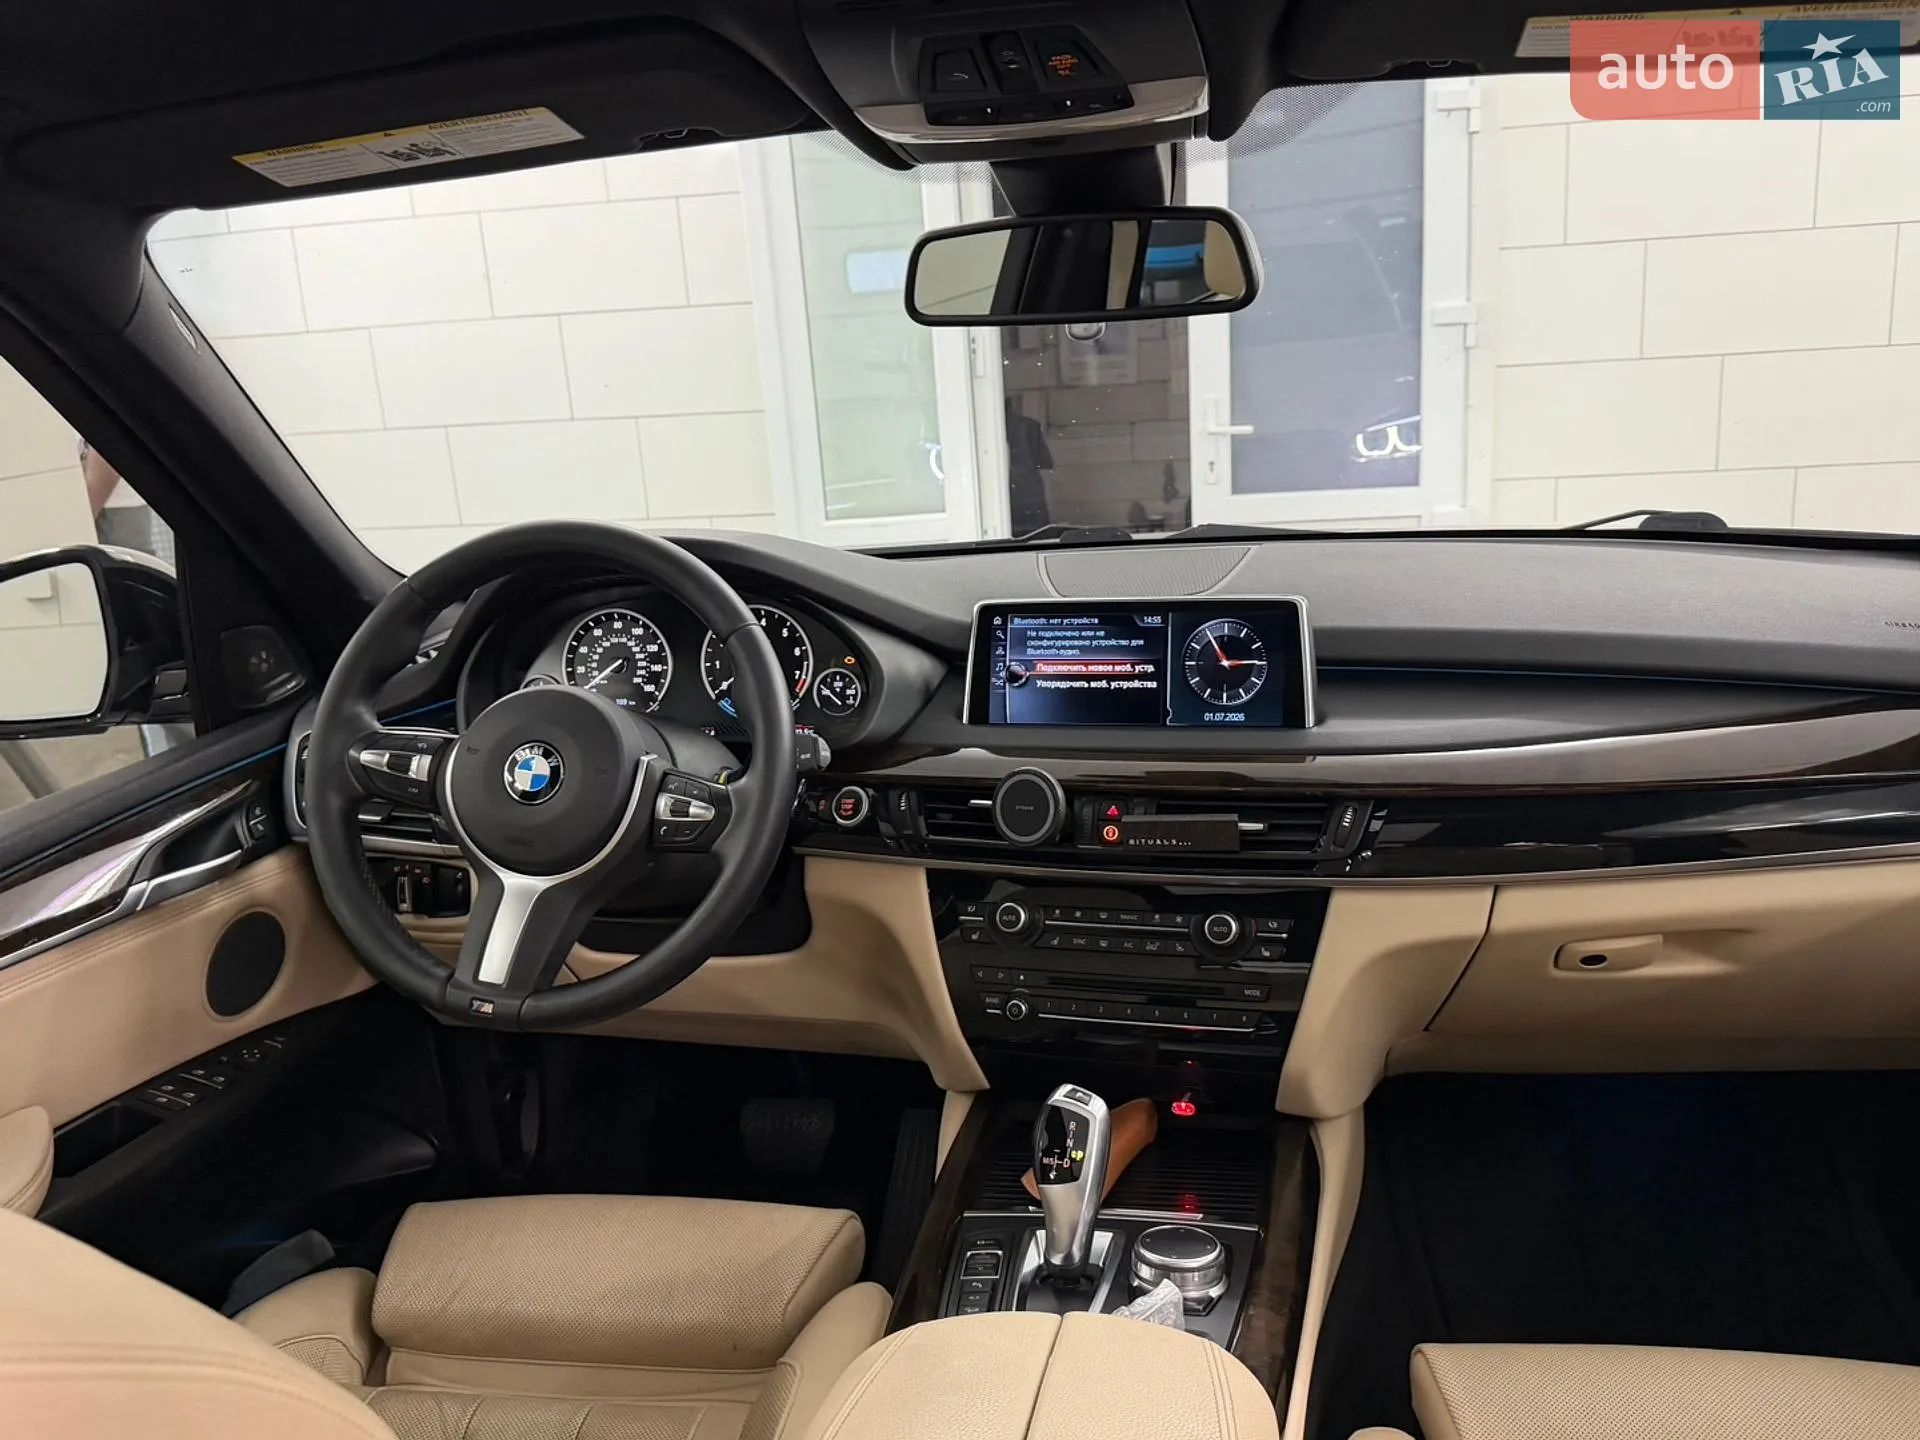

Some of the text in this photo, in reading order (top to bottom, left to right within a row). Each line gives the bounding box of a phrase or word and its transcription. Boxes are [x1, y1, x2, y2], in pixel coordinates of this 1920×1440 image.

[1063, 617, 1099, 626] устройств
[1143, 616, 1162, 624] 14:55
[631, 627, 644, 636] 100
[782, 628, 789, 637] 5
[1038, 630, 1079, 638] подключено
[1092, 638, 1129, 647] устройство
[1130, 639, 1144, 647] для
[646, 644, 658, 652] 120
[794, 647, 800, 656] 6
[715, 660, 720, 669] 1
[1036, 663, 1155, 673] Подключить новое моб. устр.
[794, 671, 800, 679] 7
[1036, 680, 1157, 690] Упорядочить моб. устройства
[1204, 713, 1245, 721] 01.07.2026
[514, 745, 560, 767] BMW
[1213, 925, 1228, 933] AUTO
[1244, 989, 1261, 997] MODE
[1069, 1121, 1076, 1131] R
[1062, 1158, 1071, 1168] D
